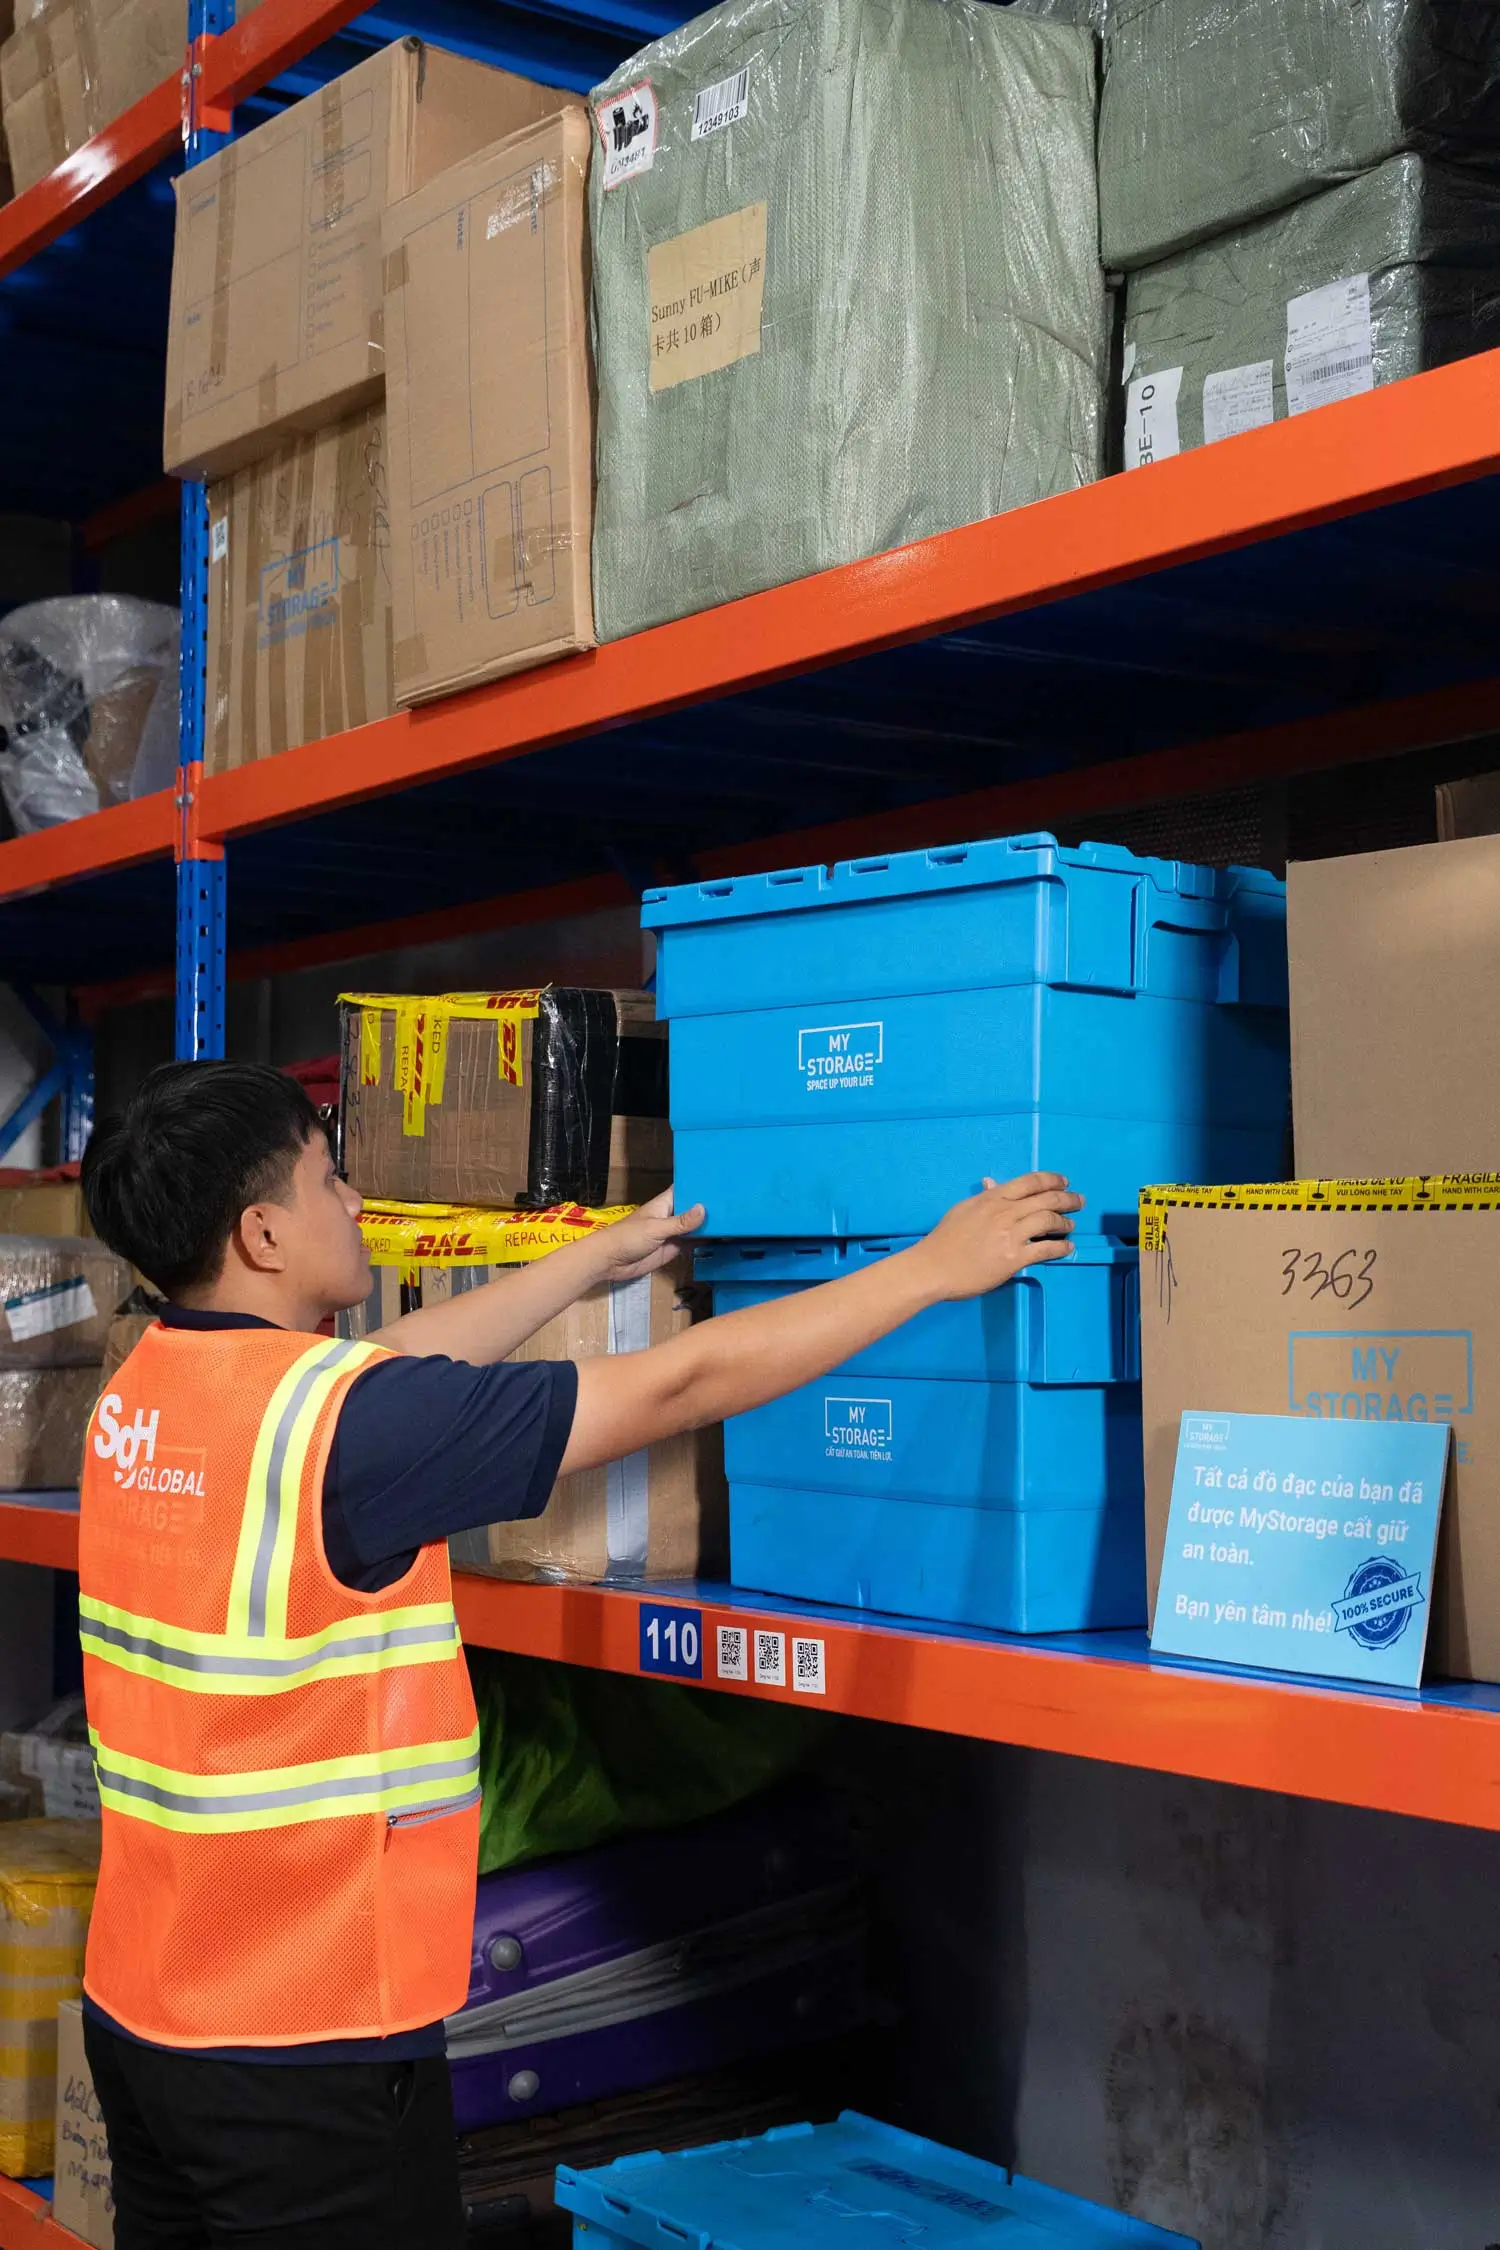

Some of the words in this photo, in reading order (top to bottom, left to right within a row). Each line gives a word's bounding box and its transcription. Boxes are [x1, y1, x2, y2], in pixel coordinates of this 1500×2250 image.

[698, 105, 740, 136] 12349103
[651, 298, 685, 324] Sunny
[829, 1033, 850, 1052] MY
[400, 1045, 409, 1092] REPA
[807, 1052, 874, 1076] STORAGE
[806, 1079, 828, 1092] SPACE
[828, 1077, 839, 1089] UP
[839, 1076, 858, 1088] YOUR
[859, 1074, 874, 1086] LIFE
[1390, 1188, 1403, 1196] TAY
[1282, 1249, 1377, 1310] 3363
[1352, 1346, 1399, 1382] MY
[849, 1406, 866, 1423] MY
[1305, 1391, 1454, 1423] STORAGE
[832, 1427, 885, 1447] STORAGE
[137, 1466, 205, 1497] GLOBAL
[1194, 1465, 1222, 1488] Tất
[1227, 1467, 1248, 1490] cả
[1253, 1468, 1277, 1492] đồ
[1282, 1472, 1315, 1499] đạc
[1321, 1474, 1354, 1498] của
[1359, 1478, 1394, 1504] bạn
[1399, 1480, 1423, 1504] đã
[1187, 1501, 1234, 1528] được
[1239, 1507, 1338, 1540] MyStorage
[1343, 1515, 1372, 1539] cất
[1377, 1519, 1409, 1545] giữ
[1182, 1543, 1204, 1560] an
[1210, 1541, 1254, 1565] toàn.
[1175, 1594, 1209, 1619] Bạn
[1215, 1598, 1246, 1624] yên
[1251, 1603, 1286, 1628] tâm
[1292, 1610, 1332, 1633] nhé!
[1342, 1603, 1369, 1620] 100%
[1369, 1586, 1414, 1609] SECURE
[646, 1618, 698, 1665] 110
